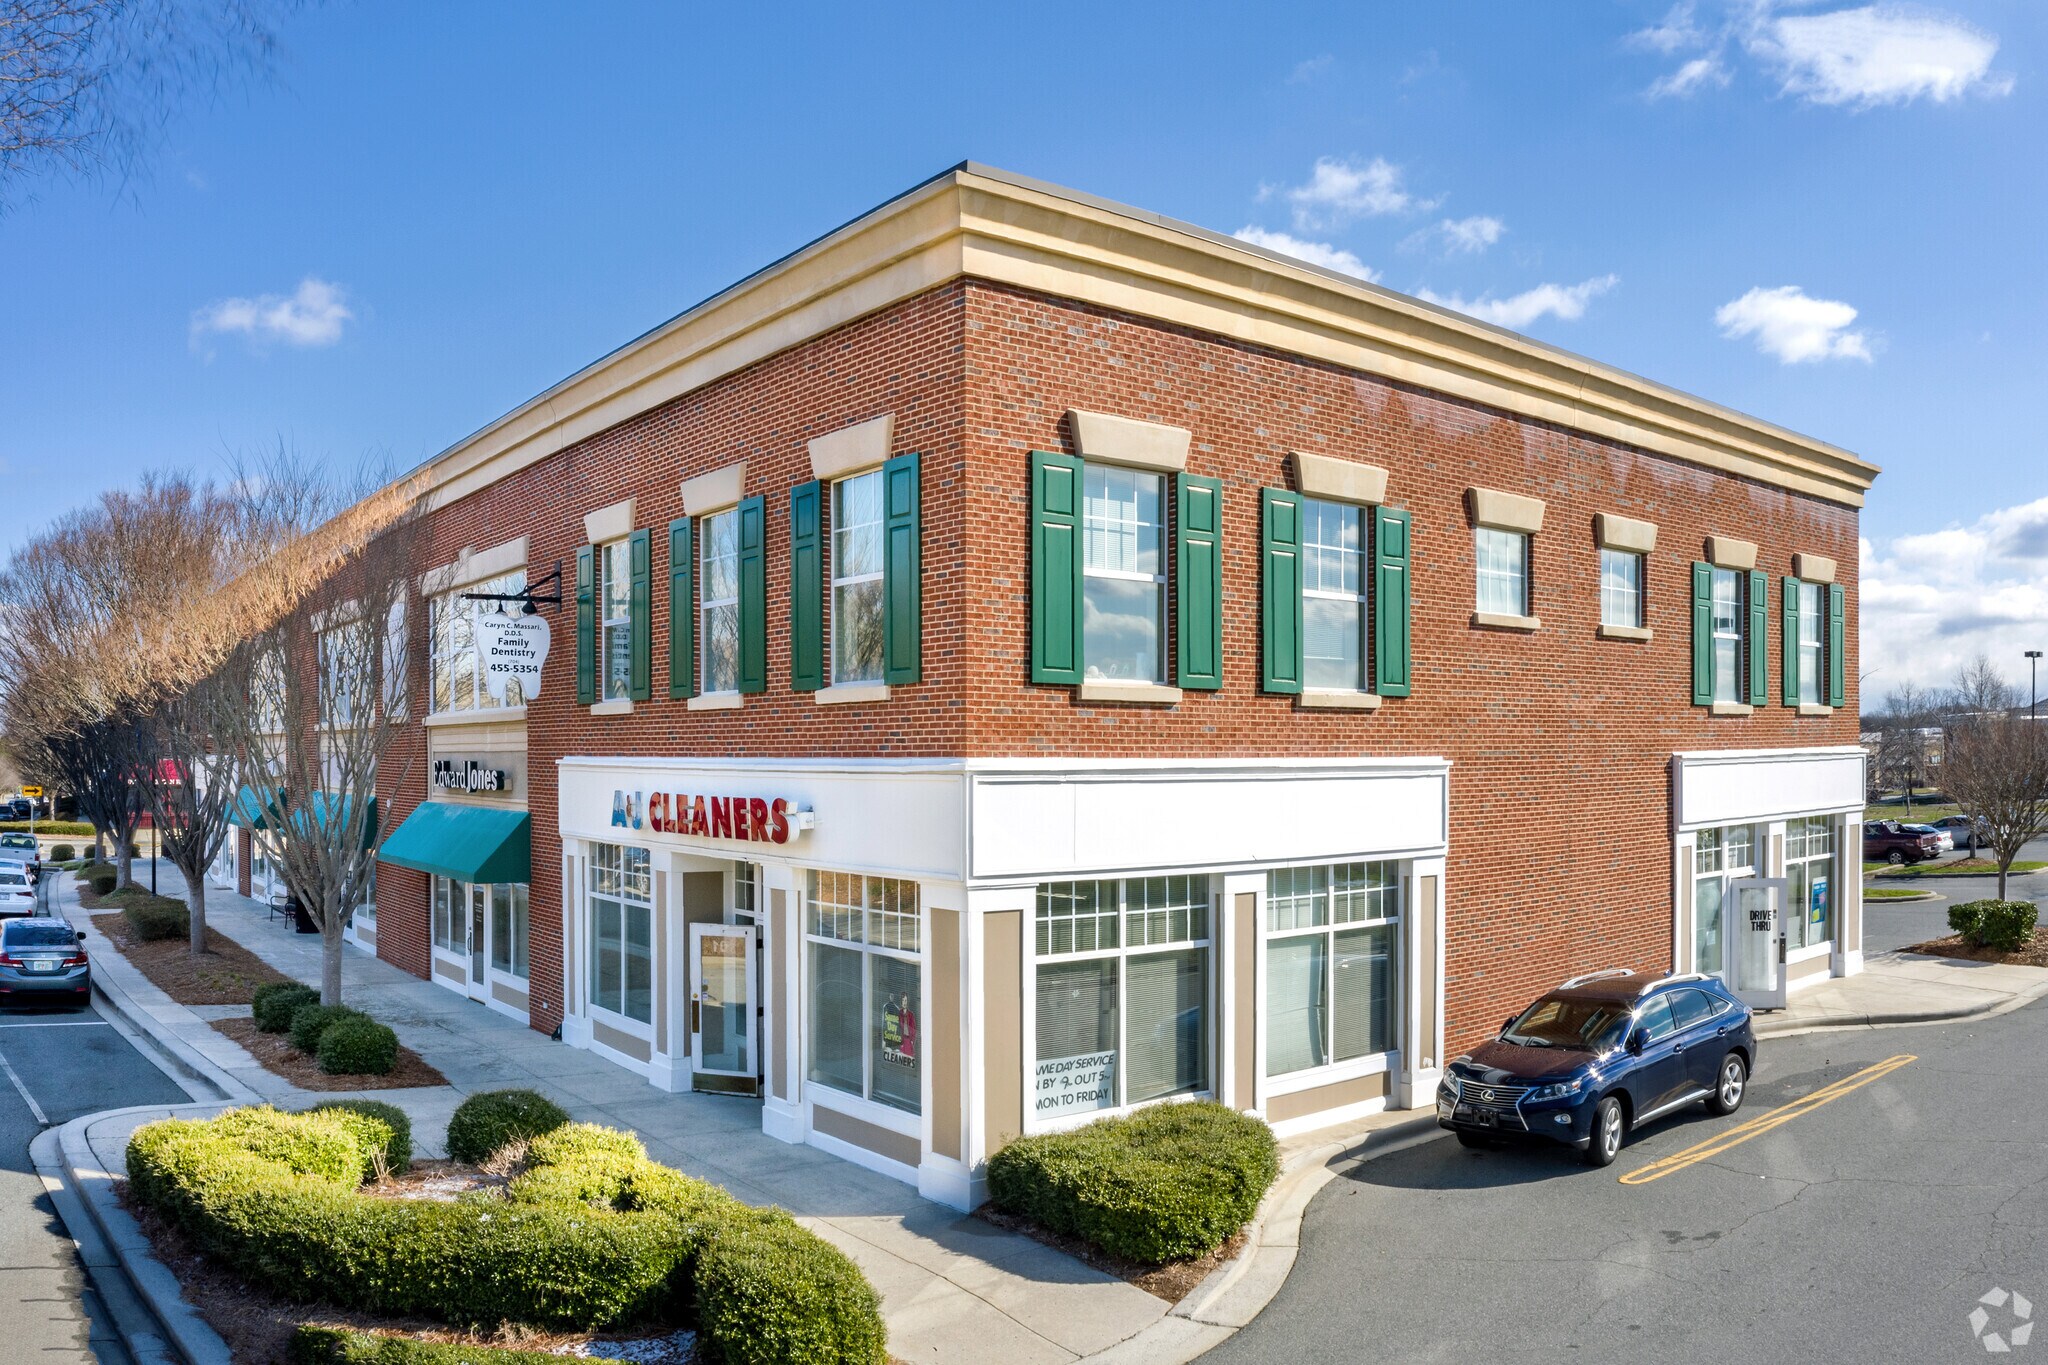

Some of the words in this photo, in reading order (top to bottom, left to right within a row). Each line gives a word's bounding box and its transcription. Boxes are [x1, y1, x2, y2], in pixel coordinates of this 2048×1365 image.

[498, 638, 529, 649] Family
[491, 647, 536, 659] Dentistry
[490, 664, 539, 673] 455-5354
[432, 760, 466, 788] Edward
[466, 760, 499, 793] Jones
[649, 791, 790, 845] CLEANERS
[1749, 910, 1771, 921] DRIVE
[1751, 921, 1771, 932] THRU
[884, 1030, 902, 1042] Service
[884, 1051, 915, 1068] CLEANERS
[1055, 1060, 1075, 1073] DAY
[1075, 1054, 1114, 1069] SERVICE
[1042, 1077, 1056, 1089] BY
[1074, 1072, 1097, 1085] OUT
[1061, 1094, 1074, 1105] TO
[1076, 1088, 1108, 1103] FRIDAY
